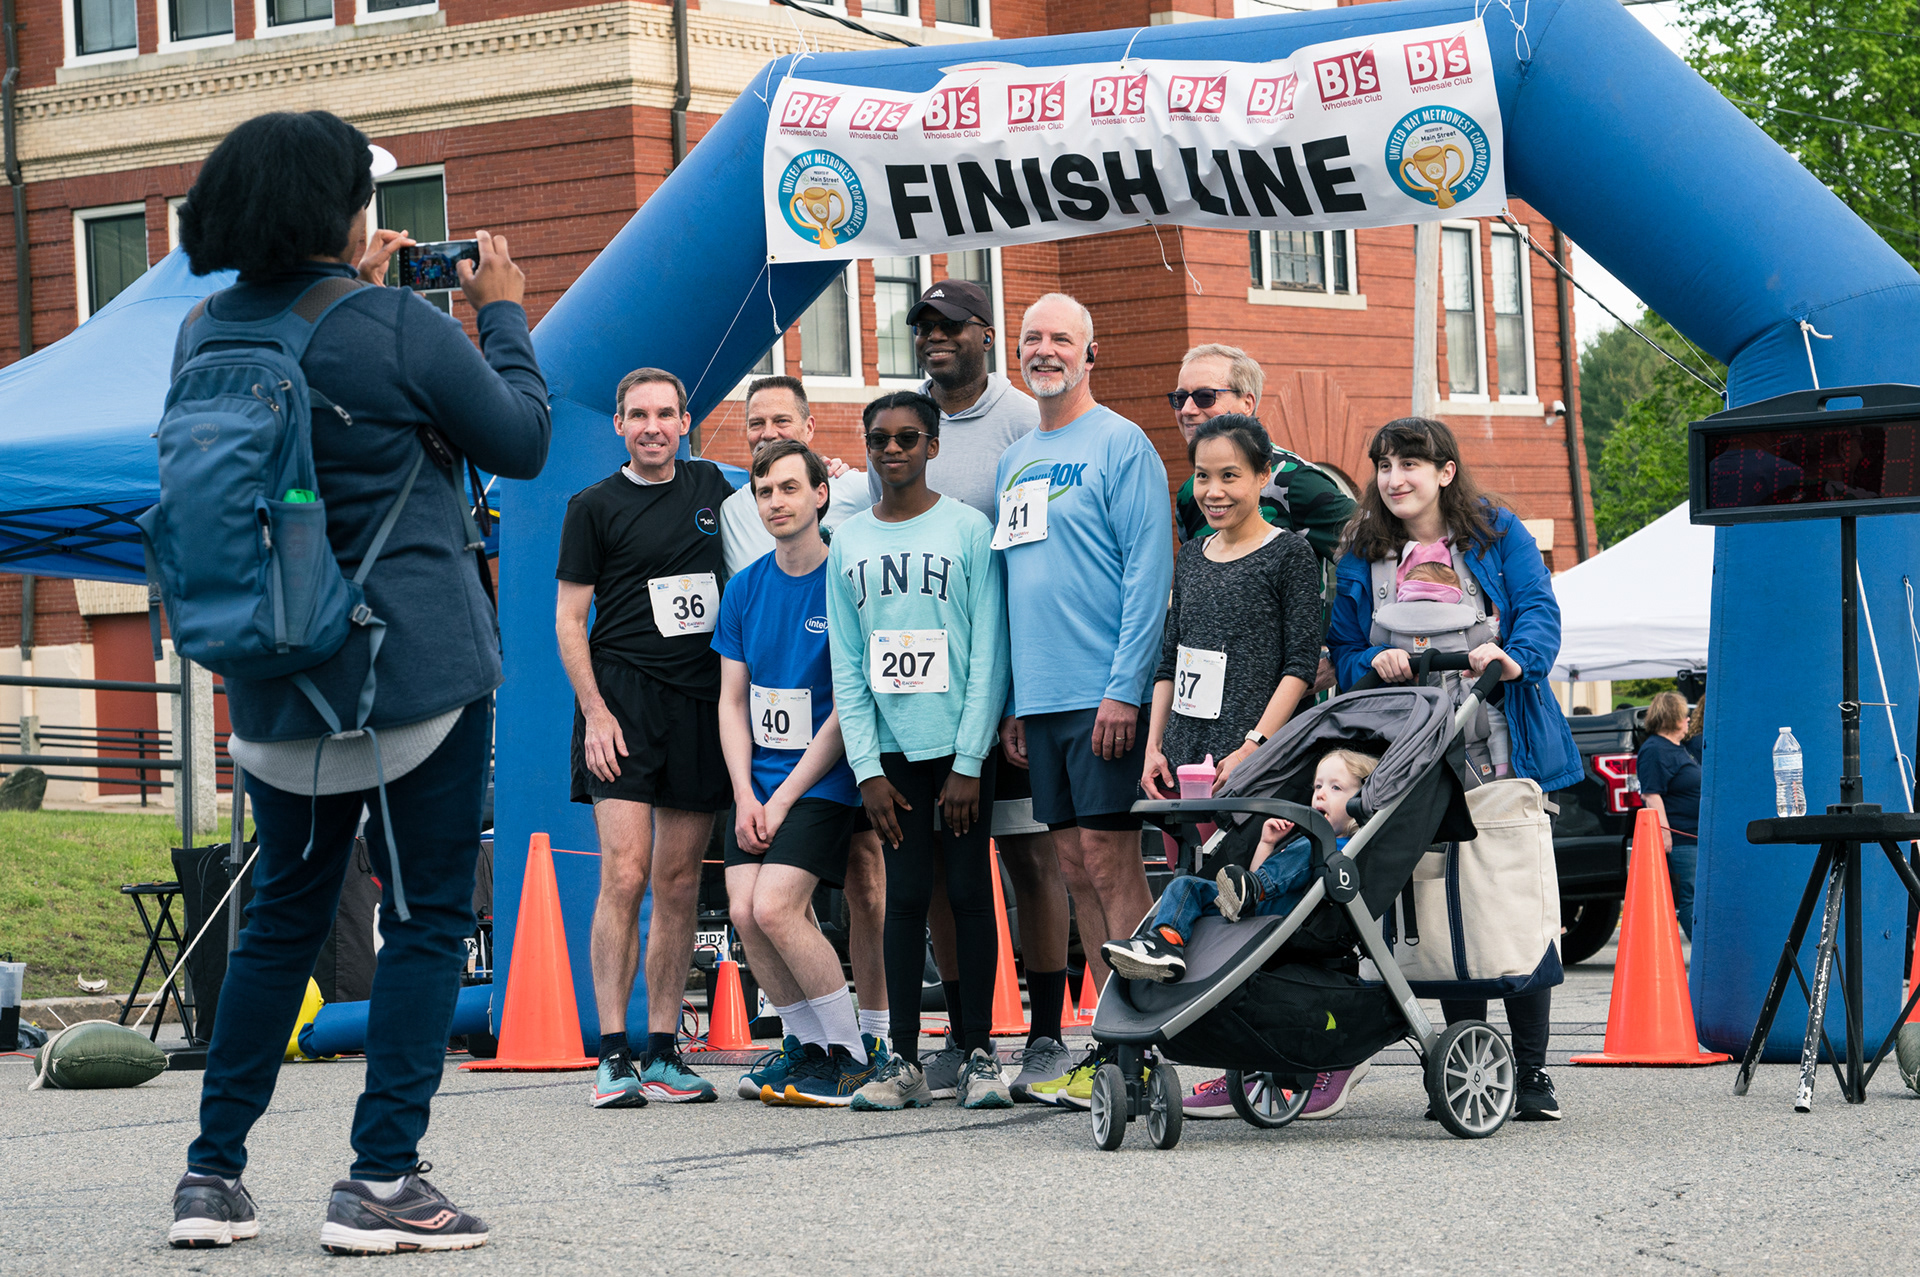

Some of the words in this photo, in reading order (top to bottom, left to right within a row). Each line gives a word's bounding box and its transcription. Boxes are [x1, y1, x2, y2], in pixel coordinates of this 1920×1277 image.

[1410, 82, 1452, 94] Wholesale
[1453, 77, 1473, 87] Club
[1321, 99, 1363, 111] Wholesale
[1364, 94, 1383, 104] Club
[1090, 117, 1127, 126] Wholesale
[1129, 115, 1146, 123] Club
[1168, 114, 1202, 122] Wholesale
[1204, 114, 1220, 122] Club
[1280, 112, 1295, 121] Club
[1402, 113, 1421, 131] WAY
[1422, 109, 1475, 133] METROWEST
[779, 128, 812, 137] Wholesale
[813, 129, 827, 138] Club
[848, 131, 881, 140] Wholesale
[882, 132, 899, 140] Club
[923, 132, 962, 140] Wholesale
[963, 129, 981, 138] Club
[1007, 125, 1046, 133] Wholesale
[1047, 122, 1064, 130] Club
[1389, 128, 1407, 160] UNITED
[1421, 134, 1436, 142] Main
[797, 154, 812, 169] WAY
[1469, 132, 1487, 182] CORPORATE
[815, 153, 856, 184] METROWEST
[782, 164, 800, 194] UNITED
[885, 148, 1171, 240] FINISH
[1179, 135, 1367, 217] LINE
[1462, 179, 1477, 192] 5K
[849, 184, 864, 229] CORPORATE
[843, 225, 856, 237] 5K
[1050, 463, 1088, 486] 10K
[1008, 503, 1028, 530] 41
[672, 594, 705, 620] 36
[808, 617, 827, 630] intel
[882, 652, 935, 677] 207
[1179, 670, 1201, 699] 37
[762, 709, 790, 734] 40
